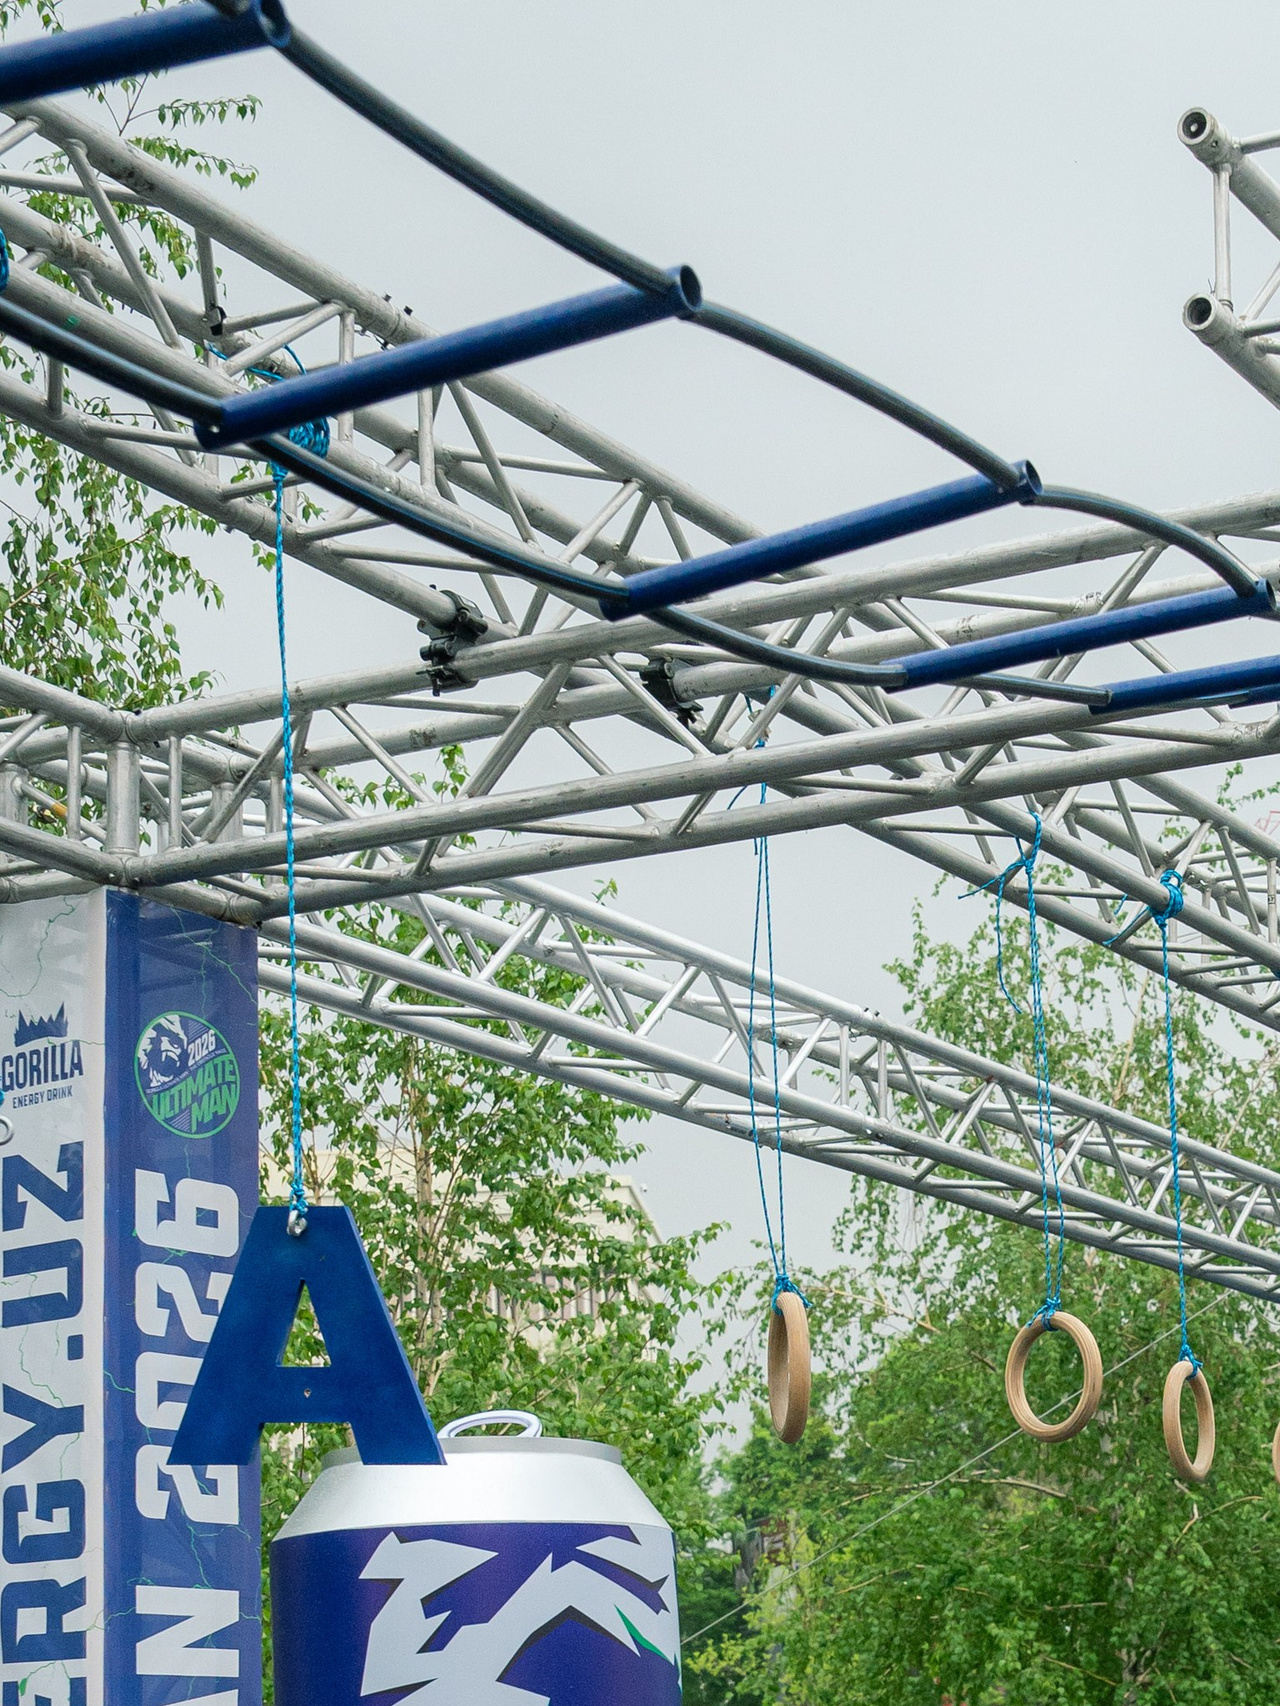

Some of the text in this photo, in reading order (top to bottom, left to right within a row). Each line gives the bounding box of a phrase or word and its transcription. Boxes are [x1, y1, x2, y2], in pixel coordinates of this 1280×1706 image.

[2, 1040, 84, 1093] GORILLA
[188, 1029, 216, 1066] 2026
[13, 1085, 73, 1109] ENERGY DRINK
[151, 1058, 237, 1121] ULTIMATE
[191, 1083, 236, 1134] MAN
[135, 1168, 240, 1525] 2026
